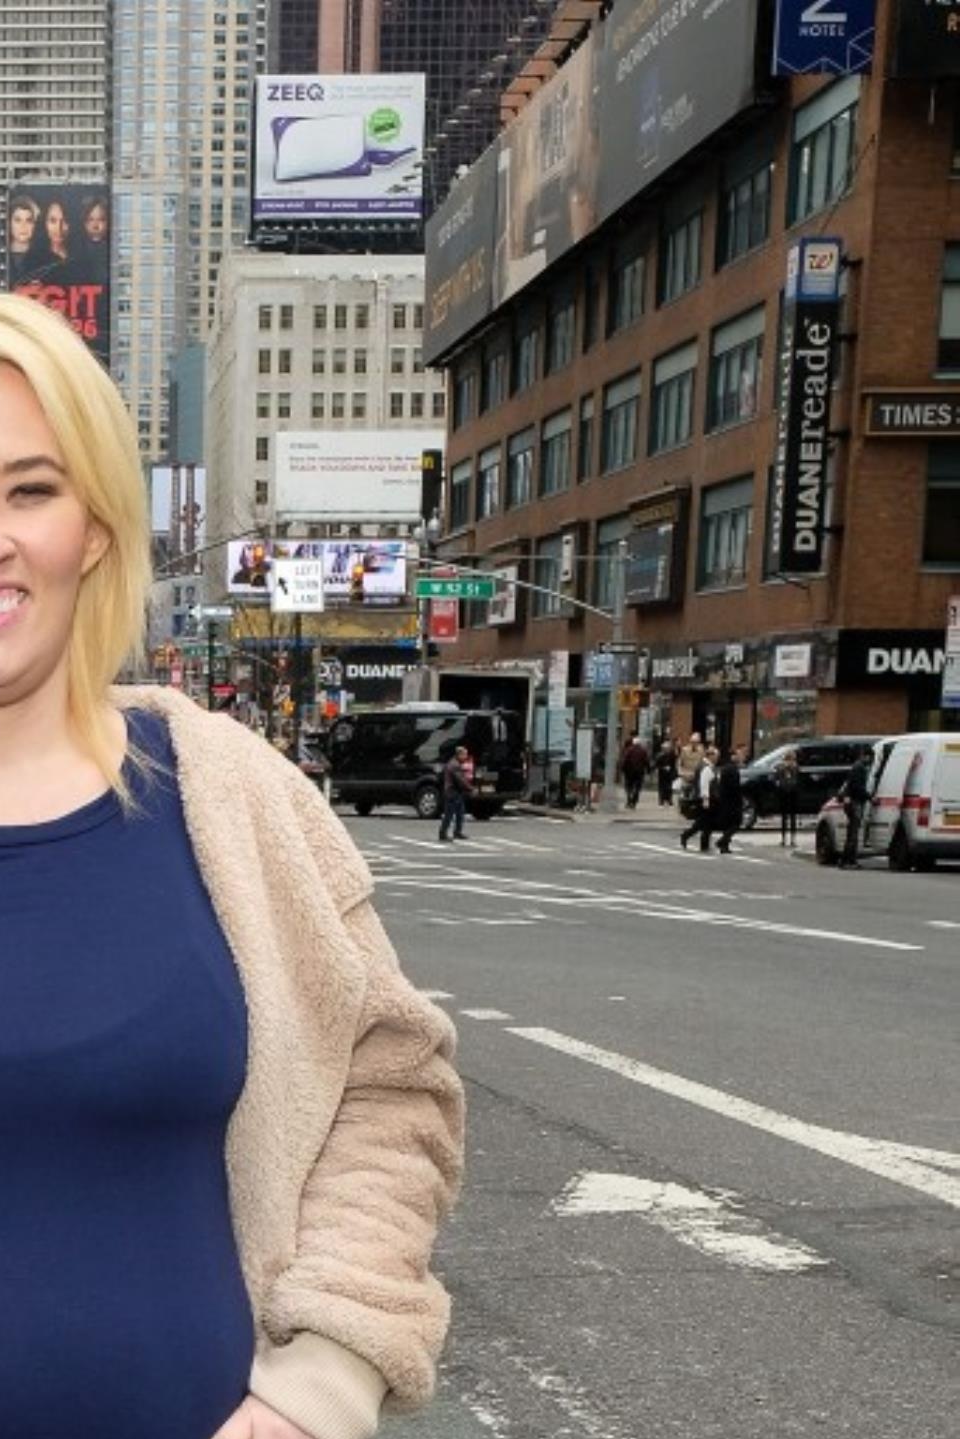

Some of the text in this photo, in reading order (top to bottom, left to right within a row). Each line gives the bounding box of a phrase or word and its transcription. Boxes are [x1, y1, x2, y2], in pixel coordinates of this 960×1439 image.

[799, 24, 845, 37] HOTEL
[267, 83, 325, 101] ZEEQ
[879, 403, 952, 426] TIMES
[794, 318, 832, 552] DUANEreade
